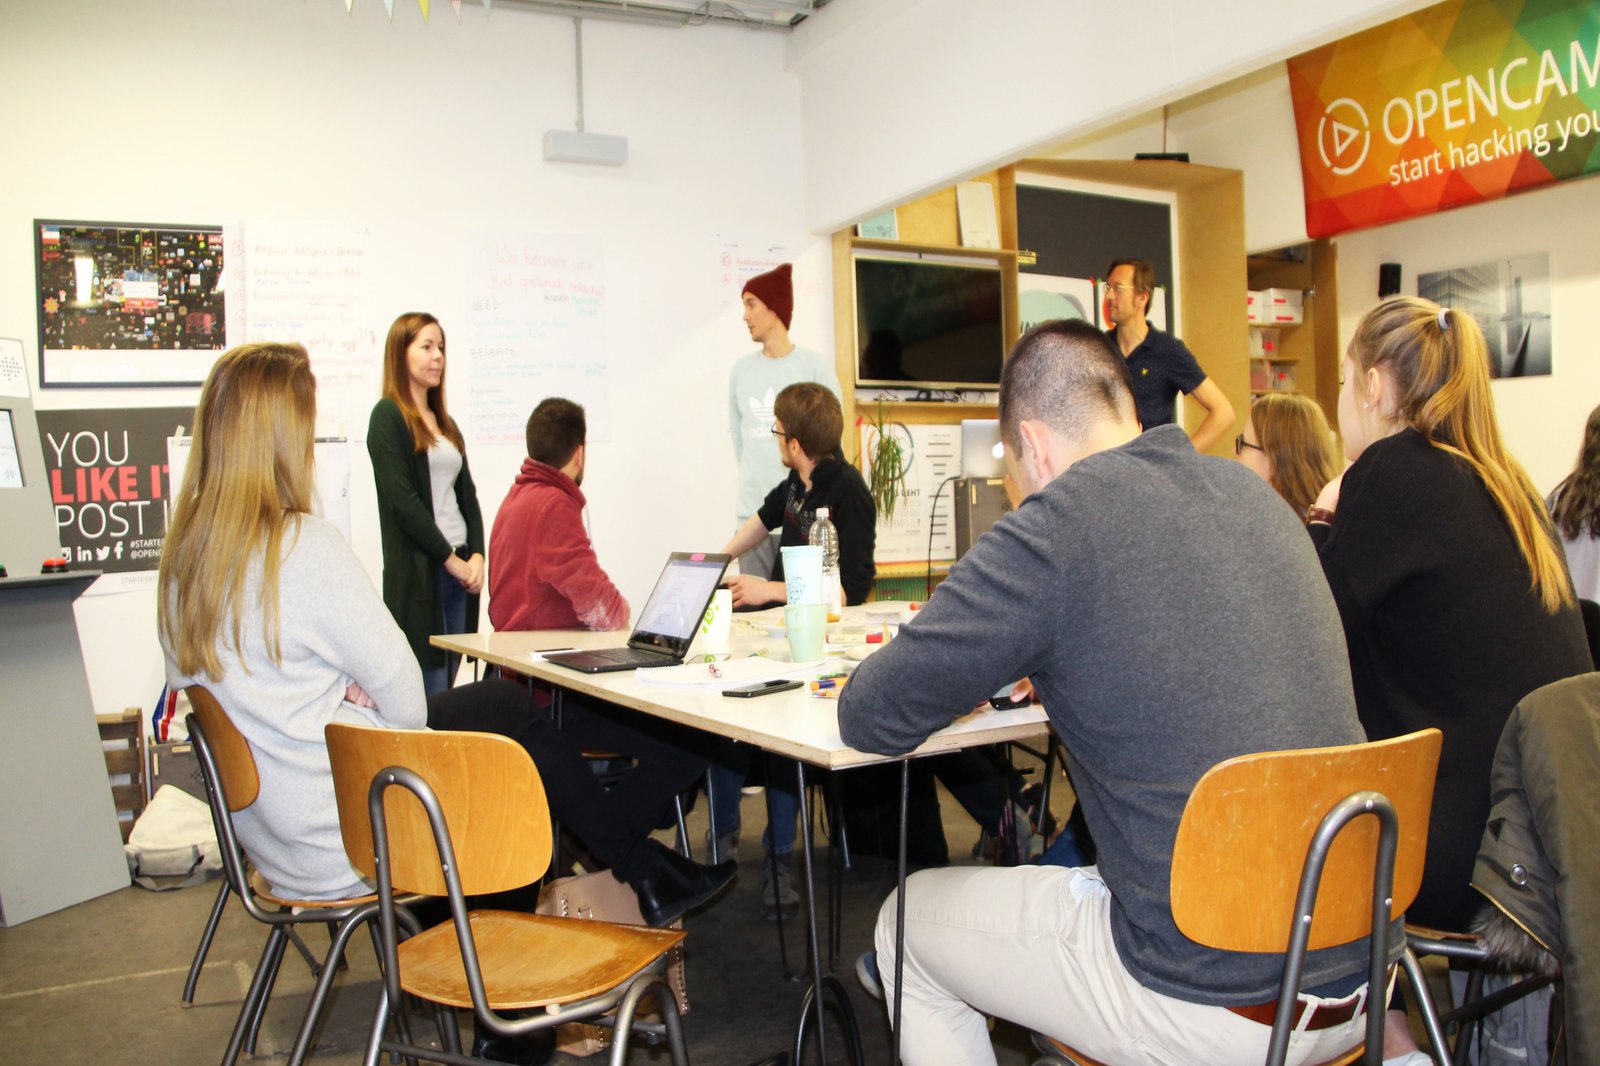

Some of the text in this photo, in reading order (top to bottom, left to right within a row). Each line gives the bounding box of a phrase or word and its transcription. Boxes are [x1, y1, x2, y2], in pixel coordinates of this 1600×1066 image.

[1389, 149, 1444, 187] start
[1449, 123, 1551, 170] hacking
[47, 429, 129, 468] YOU
[51, 466, 138, 503] LIKE
[341, 487, 348, 498] 2
[55, 500, 151, 539] POST
